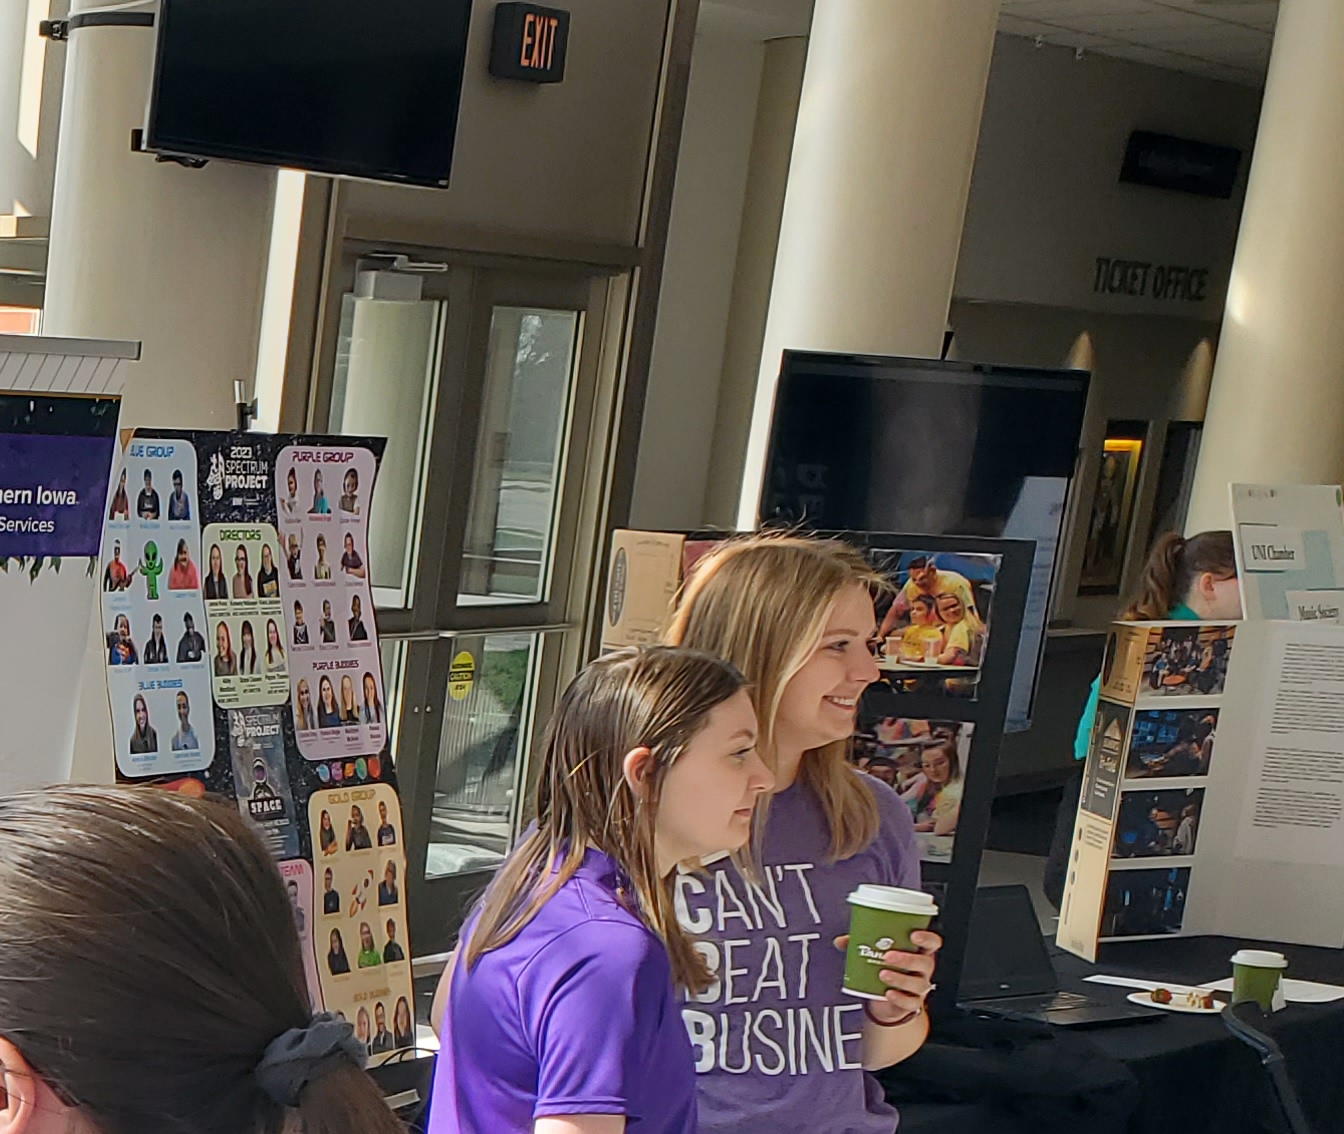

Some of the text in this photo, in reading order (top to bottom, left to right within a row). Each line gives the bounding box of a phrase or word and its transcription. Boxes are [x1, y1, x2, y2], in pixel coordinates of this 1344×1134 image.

[520, 13, 559, 71] EXIT
[1093, 256, 1210, 302] TICKET OFFICE
[145, 445, 175, 458] GROUP
[230, 446, 253, 458] 2023
[292, 451, 354, 463] PURPLE GROUP
[225, 460, 269, 474] SPECTRUM
[225, 475, 268, 489] PROJECT
[36, 485, 77, 505] Iowa
[219, 529, 262, 541] DIRECTORS
[245, 724, 281, 738] PROJECT
[250, 799, 283, 813] SPACE
[673, 863, 821, 935] CAN'T
[681, 1004, 863, 1077] BUSINE
